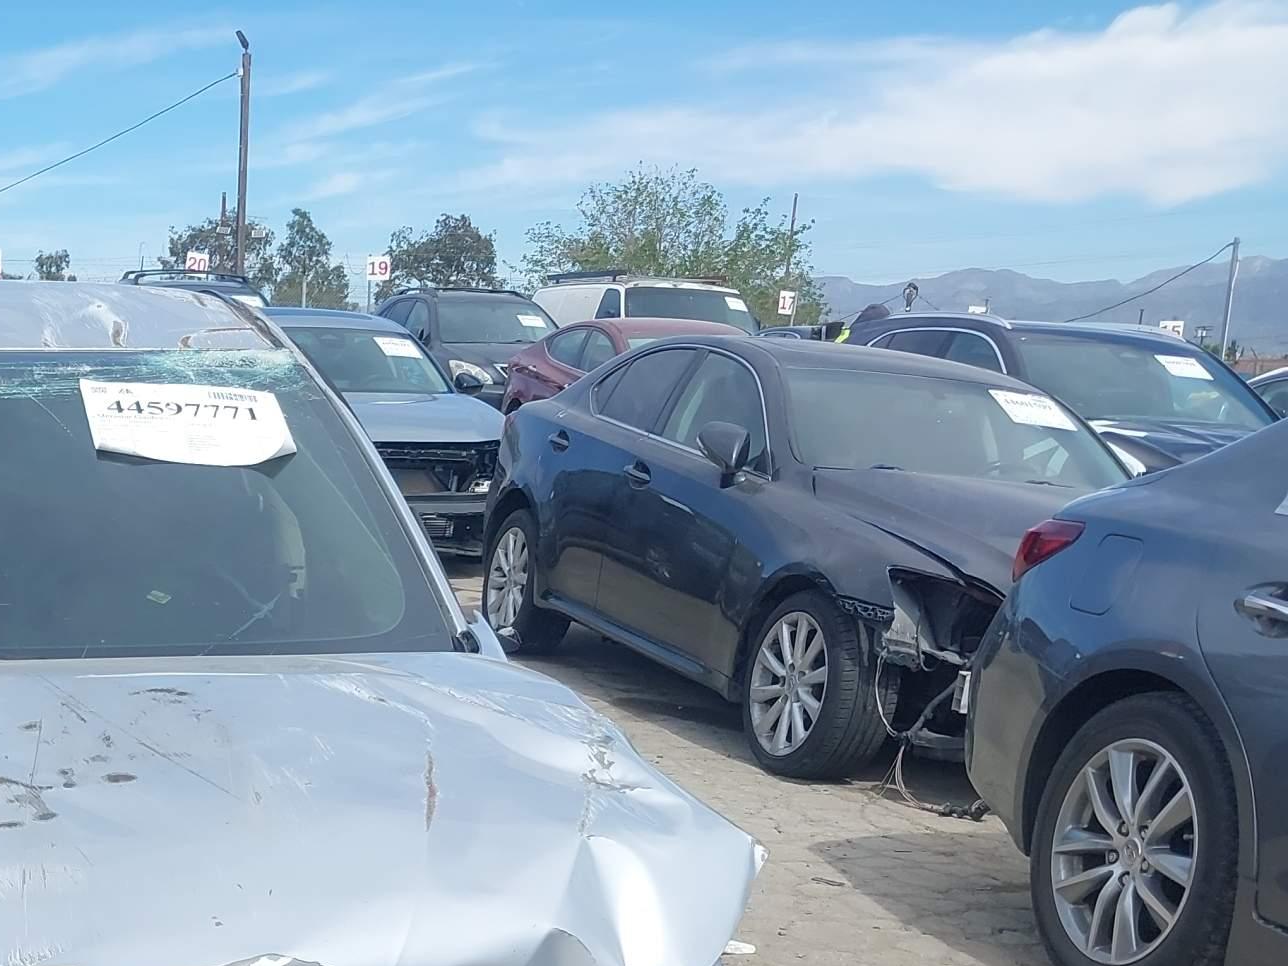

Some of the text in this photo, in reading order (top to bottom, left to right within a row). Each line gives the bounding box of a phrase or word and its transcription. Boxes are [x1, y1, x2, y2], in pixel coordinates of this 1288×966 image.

[188, 256, 207, 271] 20
[368, 261, 388, 276] 19
[780, 295, 795, 310] 17
[107, 400, 257, 421] 44597771
